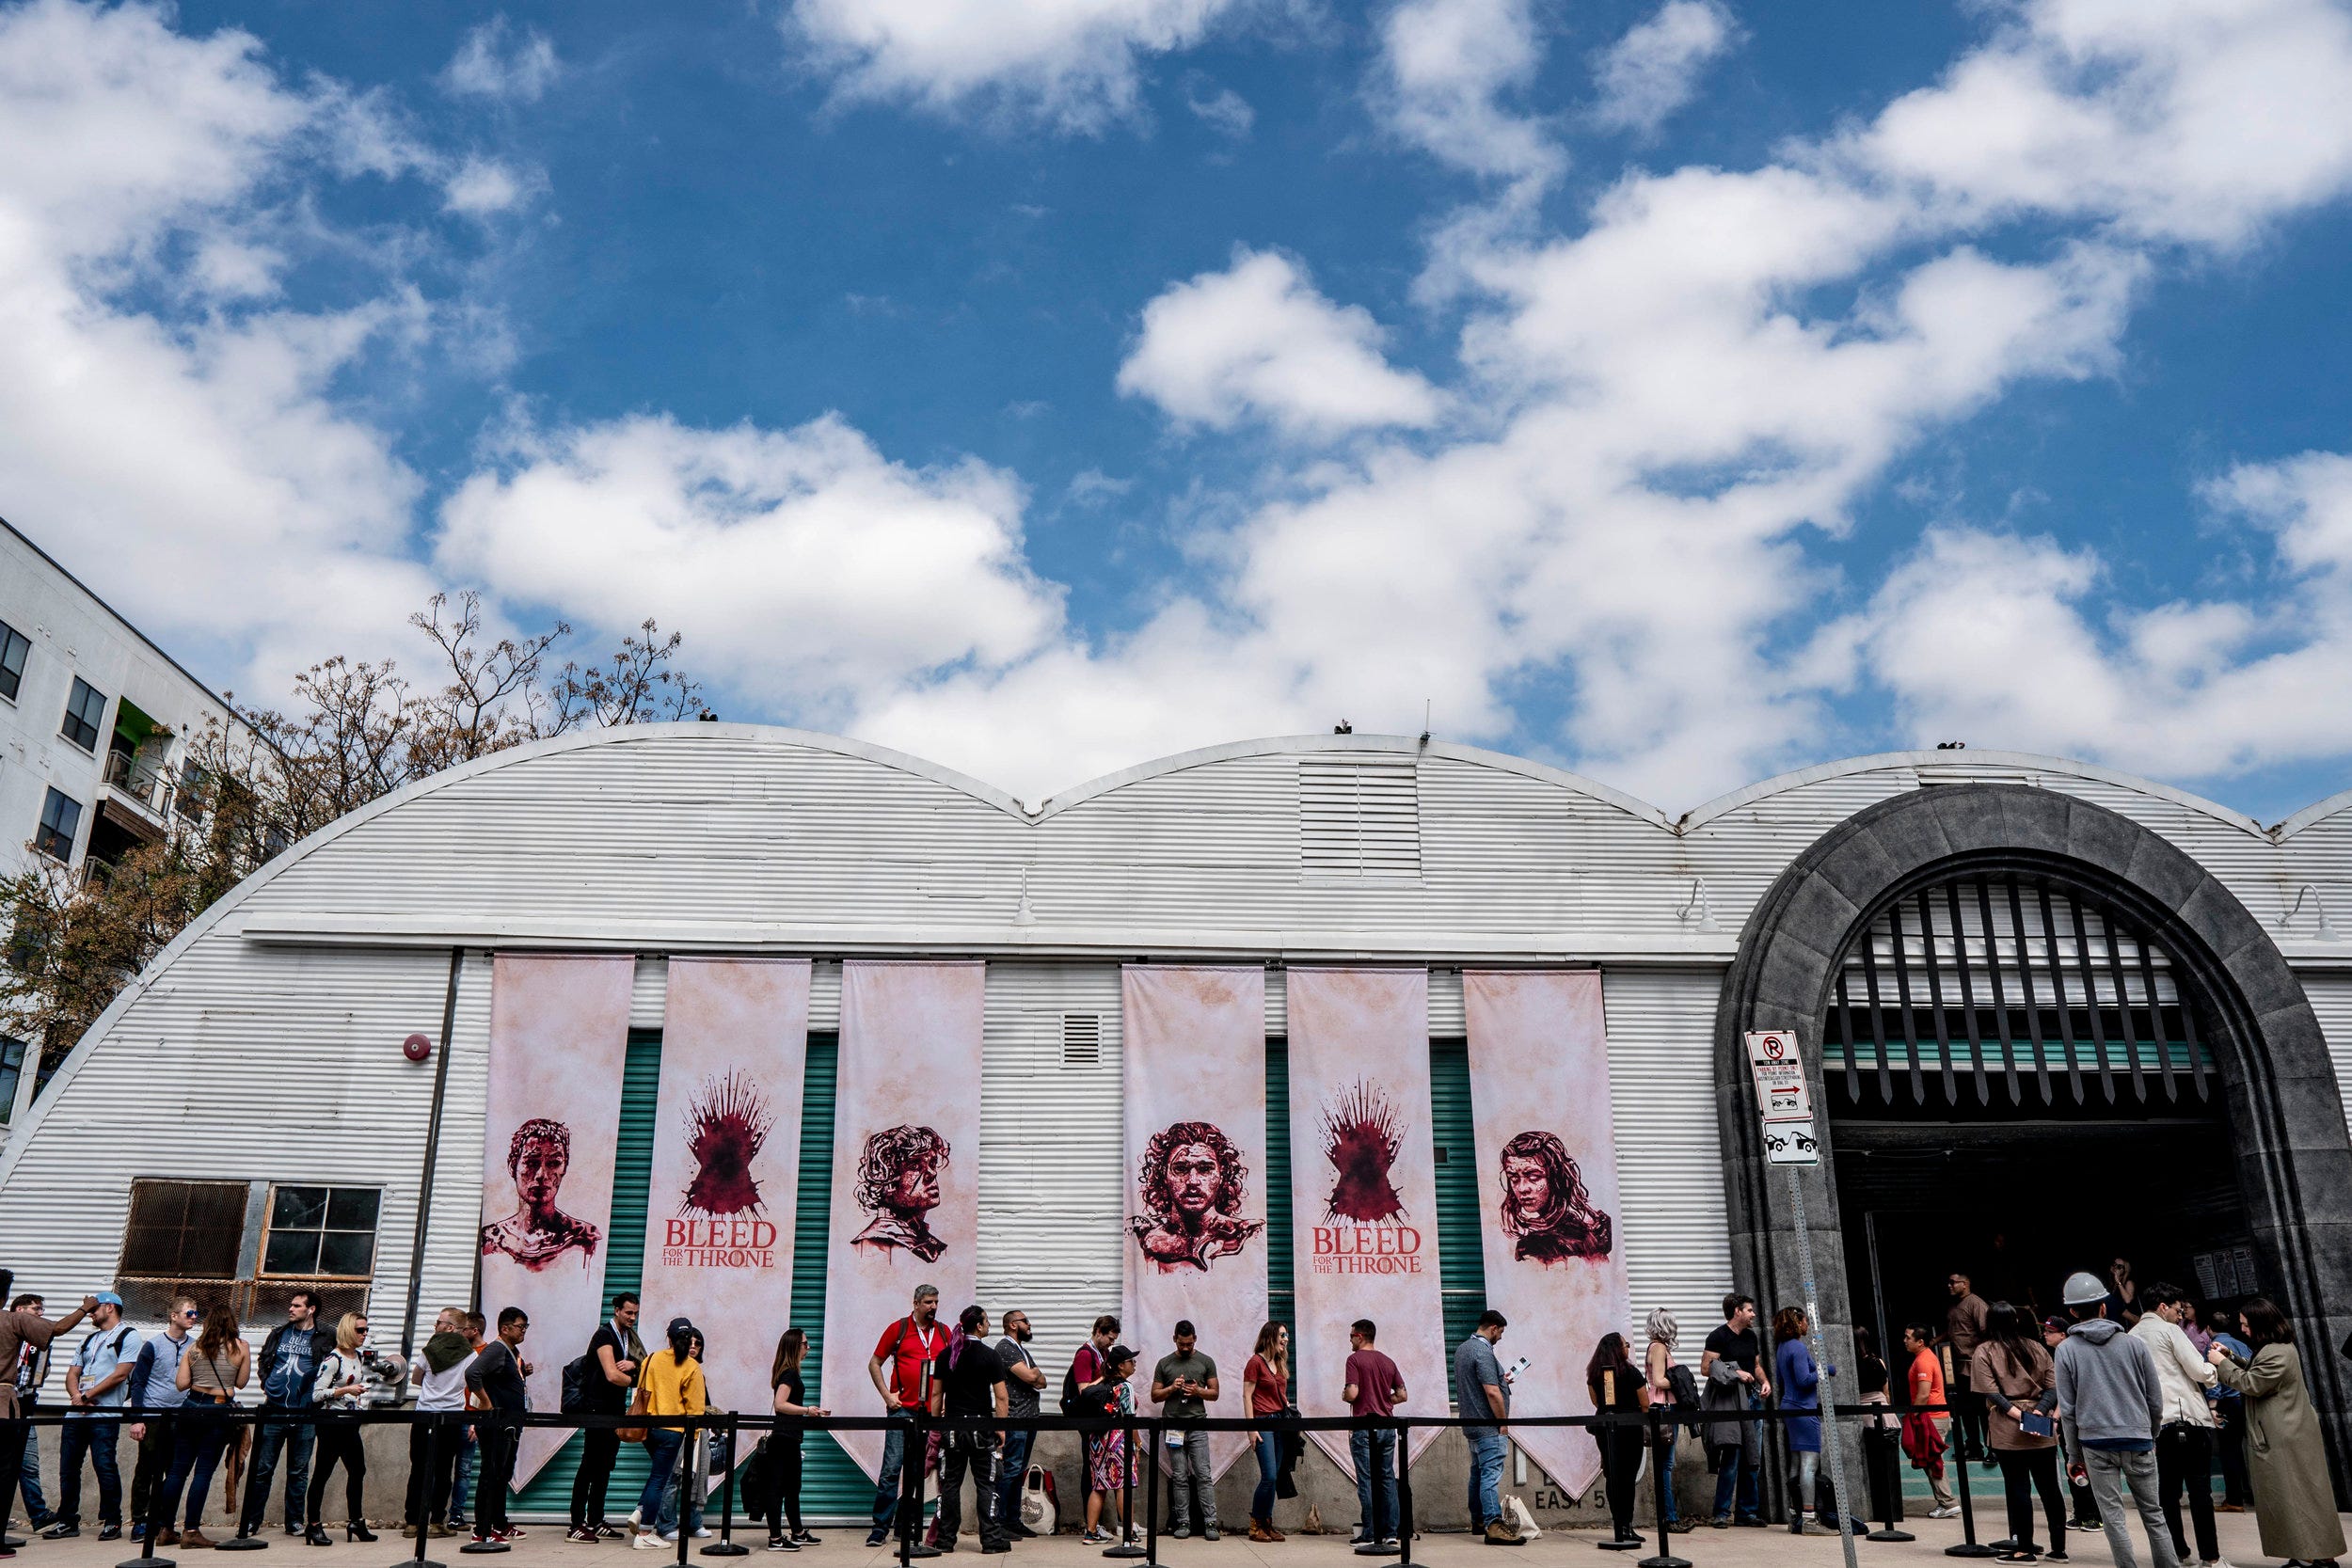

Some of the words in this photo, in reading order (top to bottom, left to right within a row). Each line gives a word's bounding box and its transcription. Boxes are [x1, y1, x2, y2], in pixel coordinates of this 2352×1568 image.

[663, 1219, 777, 1249] BLEED
[1311, 1227, 1422, 1256] BLEED
[662, 1248, 683, 1258] FOR
[684, 1249, 774, 1268] THRONE
[661, 1257, 683, 1266] THE
[1312, 1256, 1332, 1265] FOR
[1333, 1256, 1422, 1275] THRONE
[1313, 1265, 1332, 1274] THE
